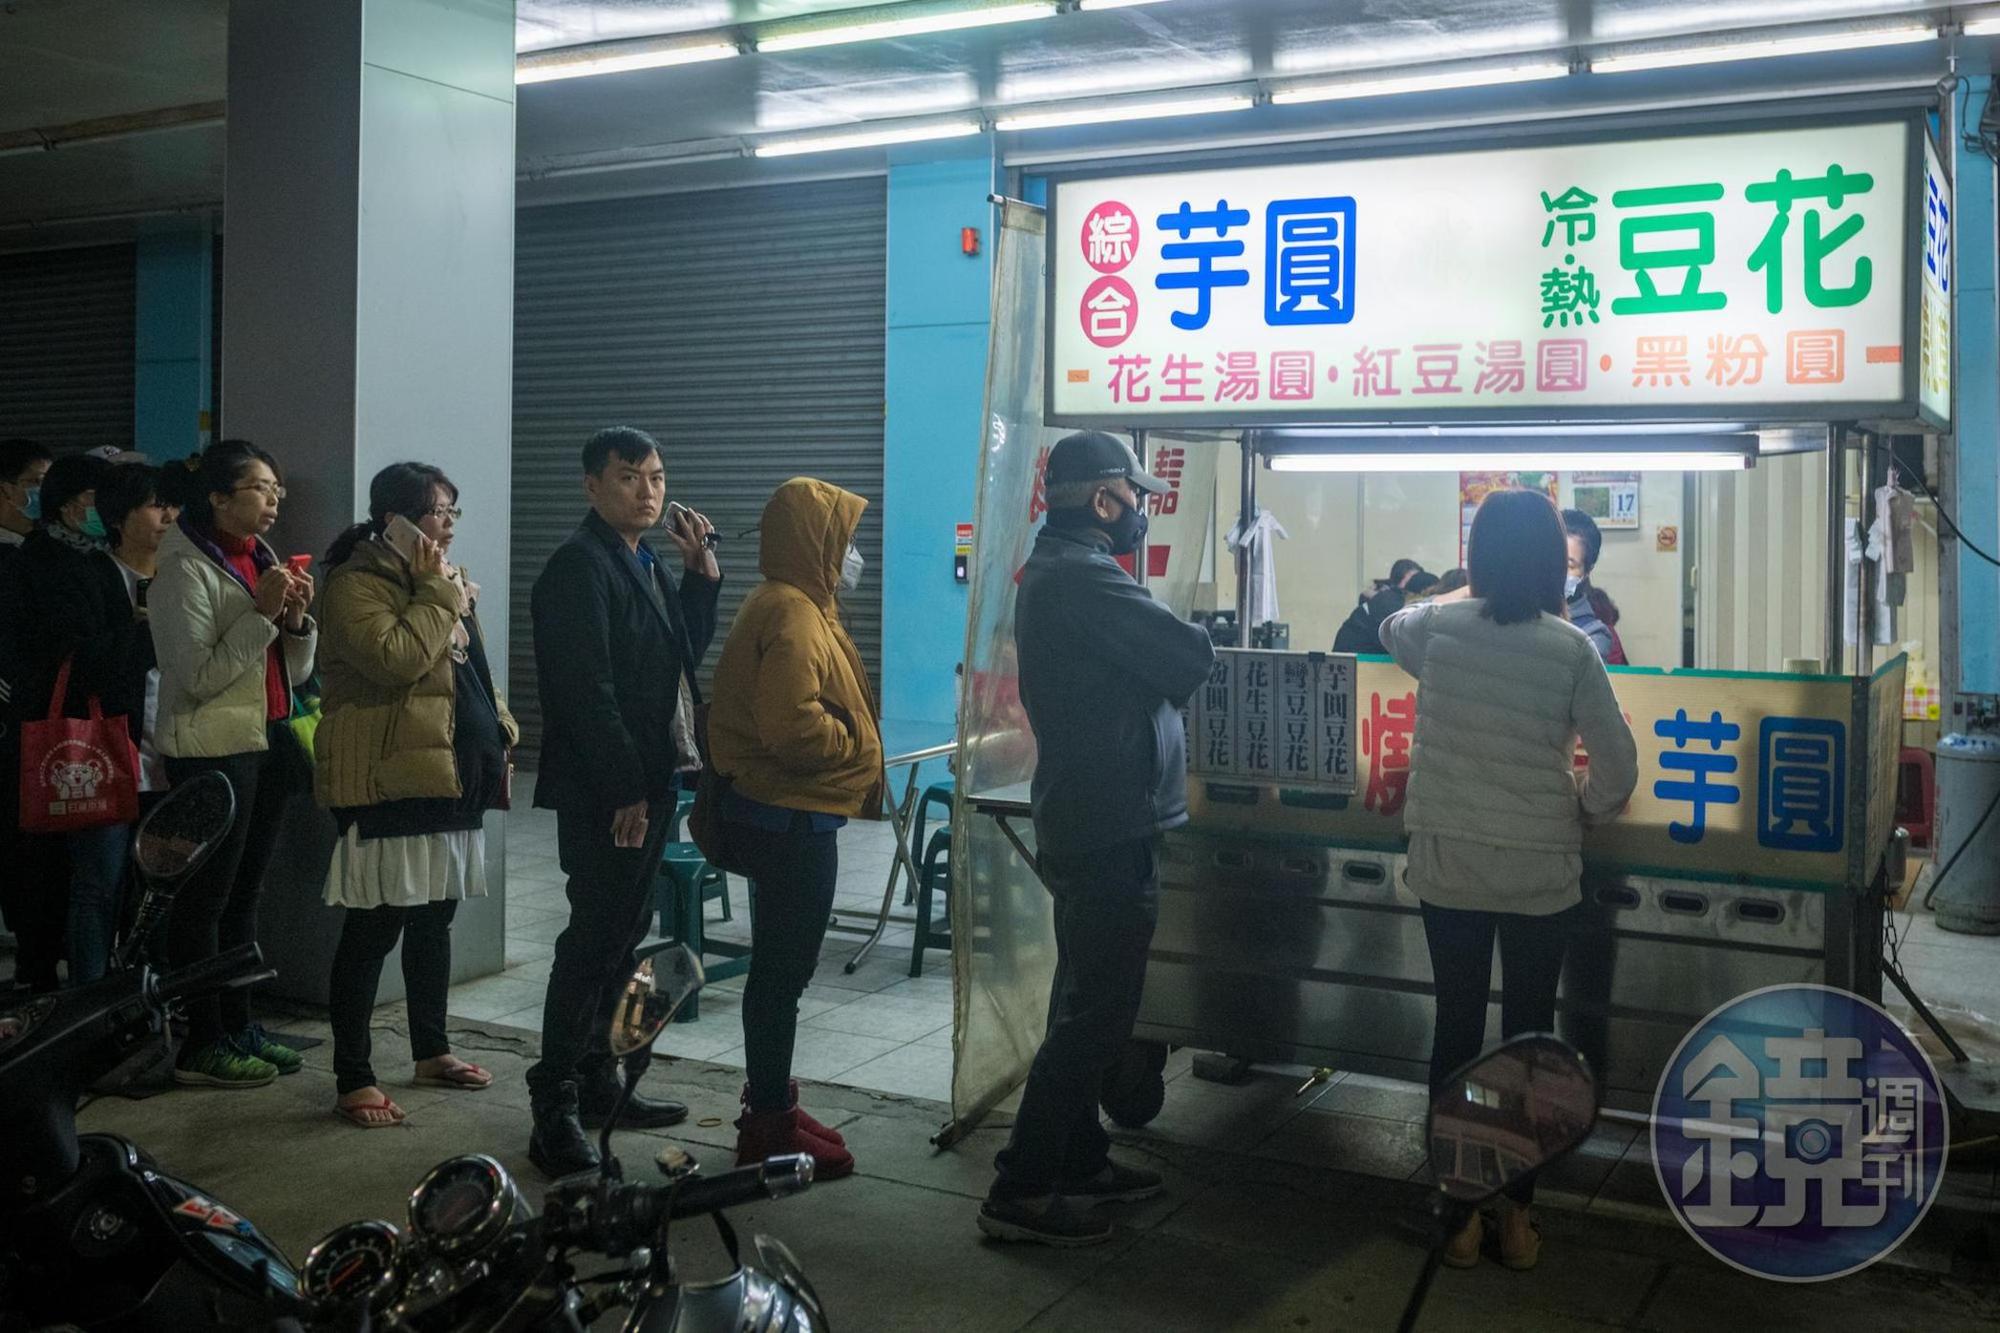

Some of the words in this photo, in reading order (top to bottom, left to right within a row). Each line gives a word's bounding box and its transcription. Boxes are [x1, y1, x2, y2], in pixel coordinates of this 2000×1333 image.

[1087, 210, 1133, 338] 綜合
[1155, 196, 1357, 331] 芋圓
[1611, 163, 1874, 315] 豆花
[1617, 493, 1635, 512] 17
[1245, 660, 1269, 770] 花生豆花
[1323, 663, 1348, 775] 芋圓豆花
[1654, 708, 1846, 852] 芋圓
